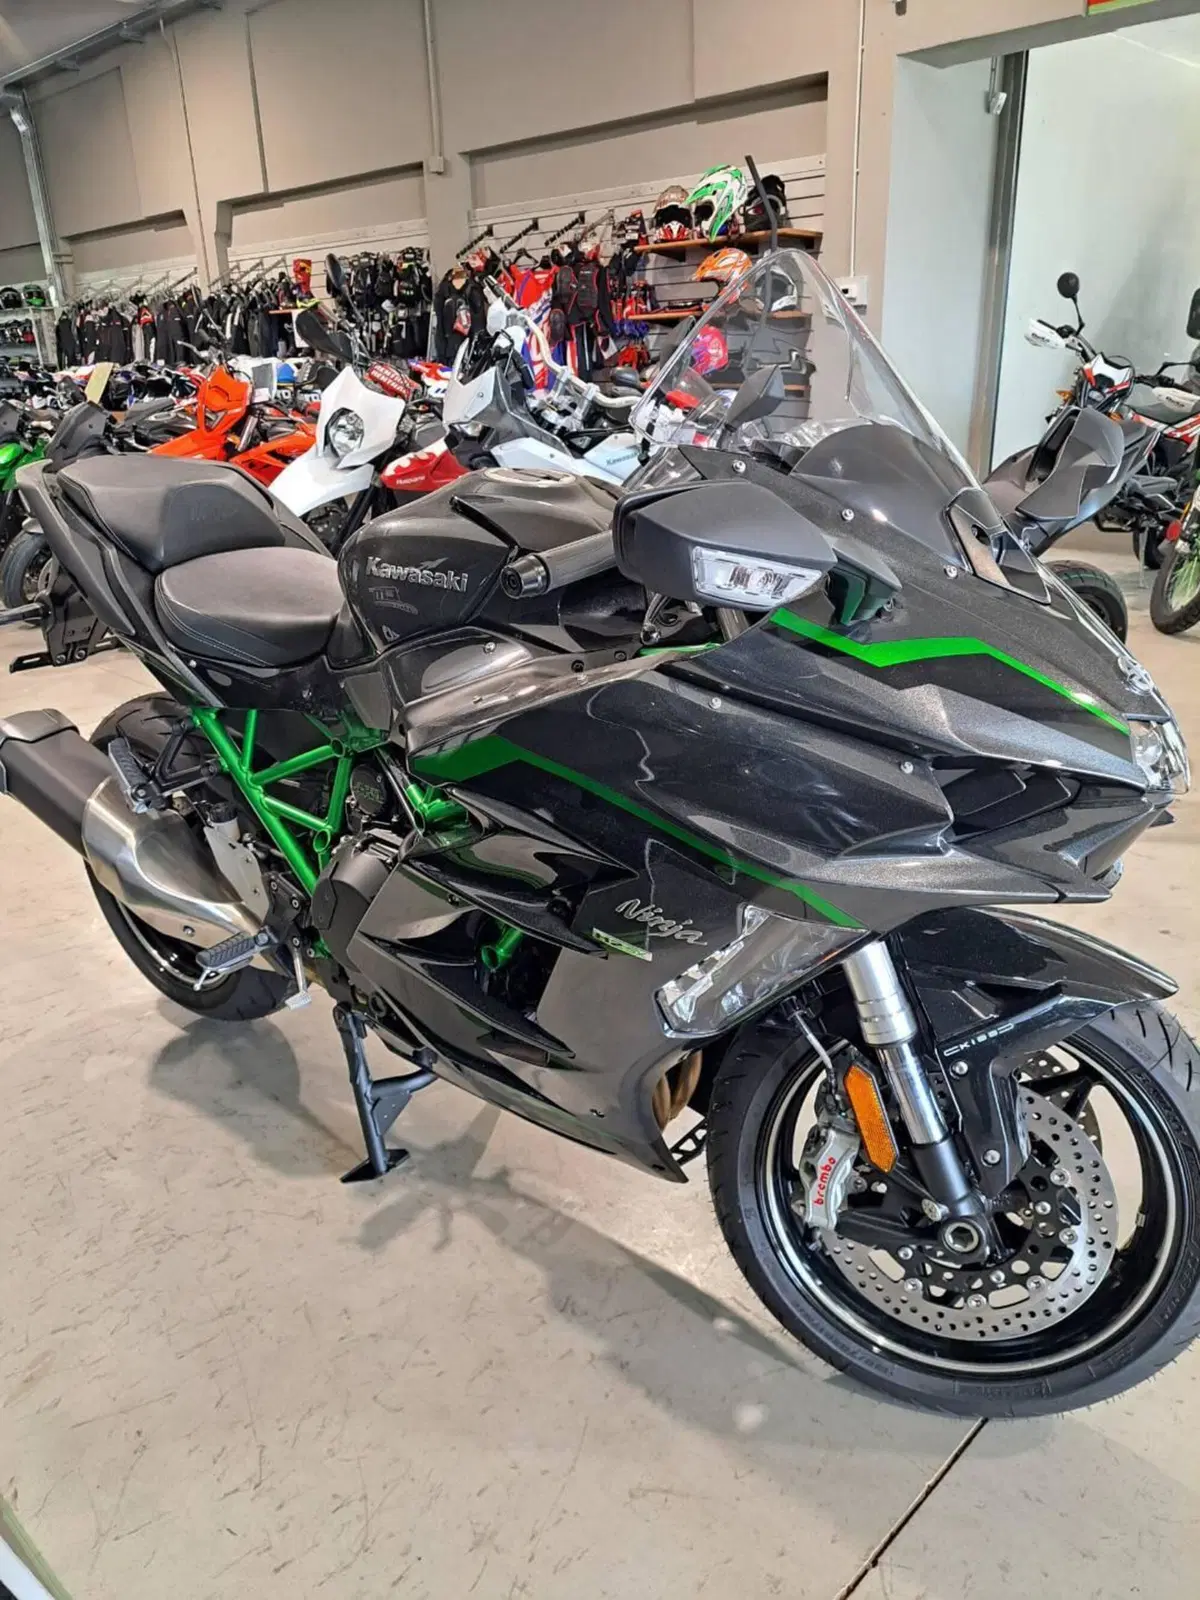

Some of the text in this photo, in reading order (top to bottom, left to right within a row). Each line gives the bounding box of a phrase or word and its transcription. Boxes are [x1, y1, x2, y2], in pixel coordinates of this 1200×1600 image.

[365, 556, 469, 593] Kawasaki
[615, 898, 708, 946] Ninja
[813, 1156, 836, 1206] brembo
